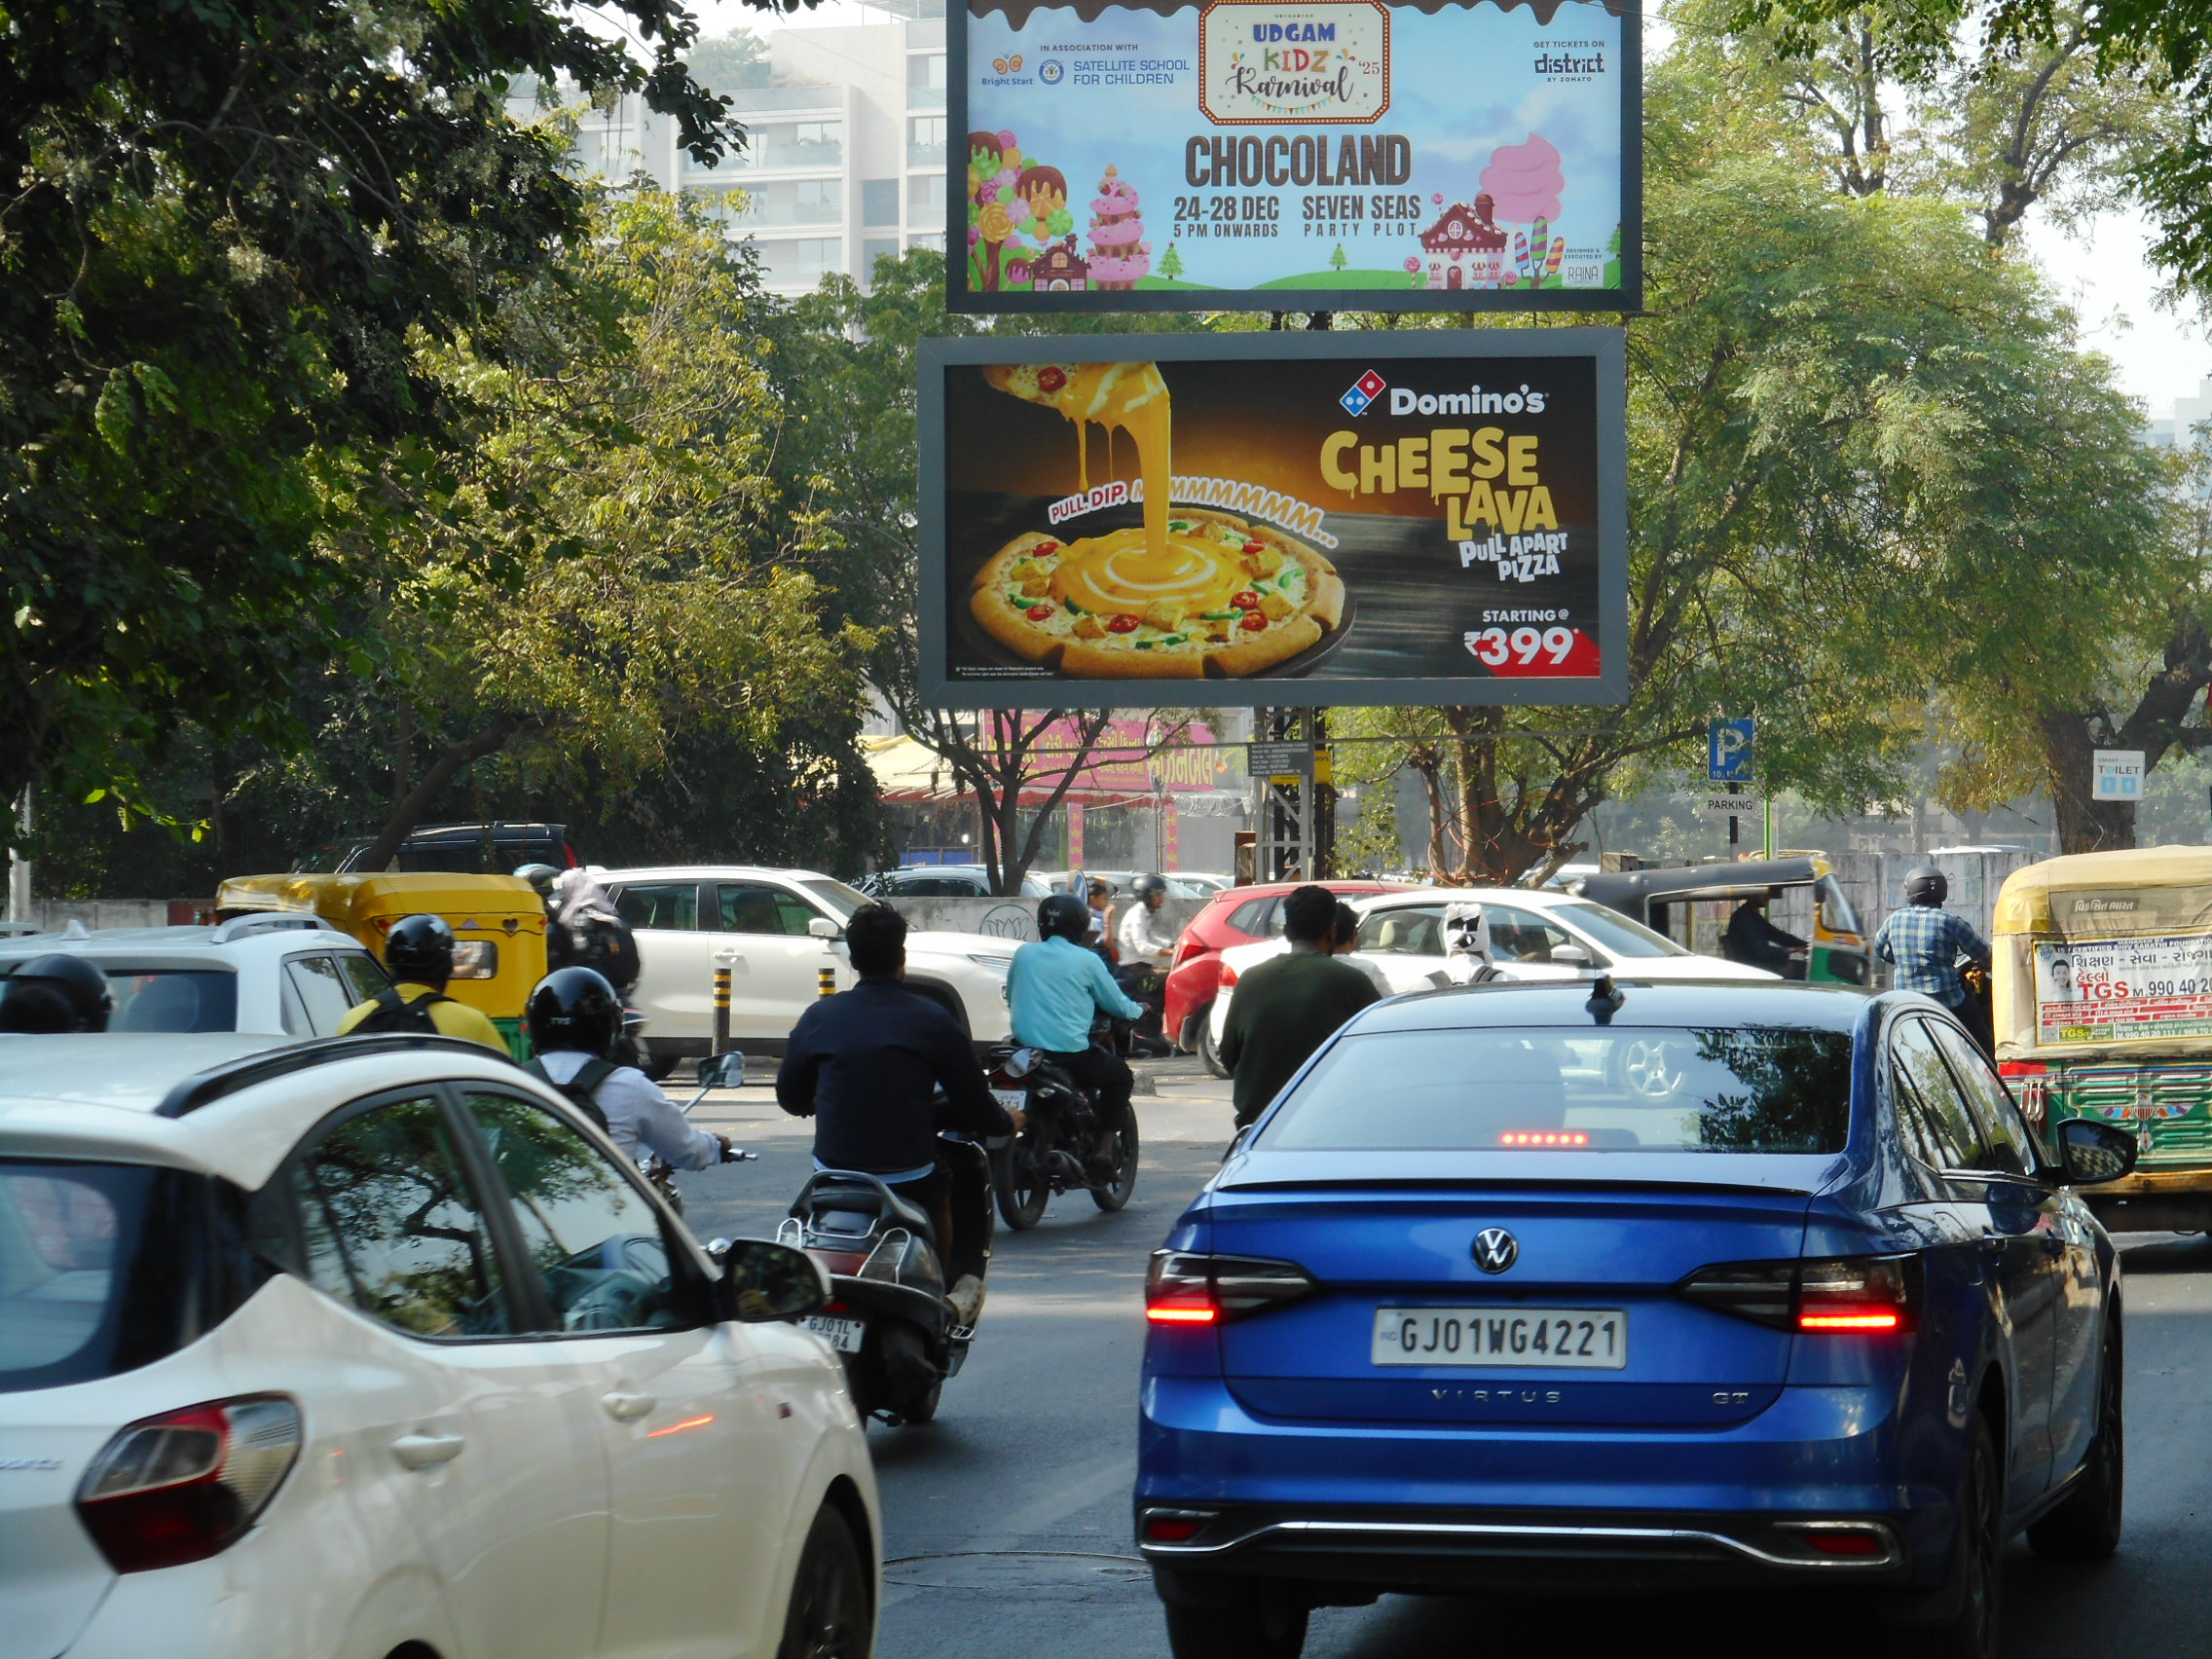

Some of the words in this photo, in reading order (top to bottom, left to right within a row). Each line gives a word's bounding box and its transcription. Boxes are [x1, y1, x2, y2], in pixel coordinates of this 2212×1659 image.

[1253, 22, 1336, 43] UDGAM
[1074, 60, 1135, 72] SATELLITE
[1140, 59, 1190, 71] SCHOOL
[1264, 48, 1330, 73] KIDZ
[1534, 53, 1604, 73] district
[981, 78, 1010, 88] Bright
[1012, 77, 1034, 86] Start
[1074, 74, 1100, 86] FOR
[1105, 73, 1174, 85] CHILDREN
[1225, 65, 1354, 102] Karnival
[1185, 134, 1412, 187] CHOCOLAND
[1174, 196, 1237, 221] 24-28
[1241, 196, 1279, 221] DEC
[1303, 195, 1364, 220] SEVEN
[1371, 195, 1421, 219] SEAS
[1174, 223, 1181, 238] 5
[1188, 223, 1208, 238] PM
[1214, 223, 1278, 238] ONWARDS
[1305, 223, 1359, 237] PARTY
[1374, 223, 1417, 236] PLOT
[1567, 266, 1599, 281] RAINA
[1390, 384, 1545, 416] Domino's
[1320, 426, 1539, 505] CHEESE
[1051, 496, 1088, 521] PULL.
[1091, 484, 1125, 507] DIP.
[1447, 480, 1558, 541] LAVA
[1509, 533, 1568, 557] APART
[1497, 554, 1561, 583] PIZZA
[1482, 609, 1557, 622] STARTING
[1559, 608, 1569, 620] @
[1708, 800, 1753, 810] PARKING
[2071, 953, 2115, 969] શિક્ષણ
[2129, 949, 2157, 965] સેવા
[2078, 981, 2129, 1001] TGS
[2179, 978, 2195, 995] 40
[1401, 1316, 1617, 1356] GJ01WG4221
[1431, 1388, 1561, 1403] VIRTUS
[1713, 1392, 1749, 1404] GT
